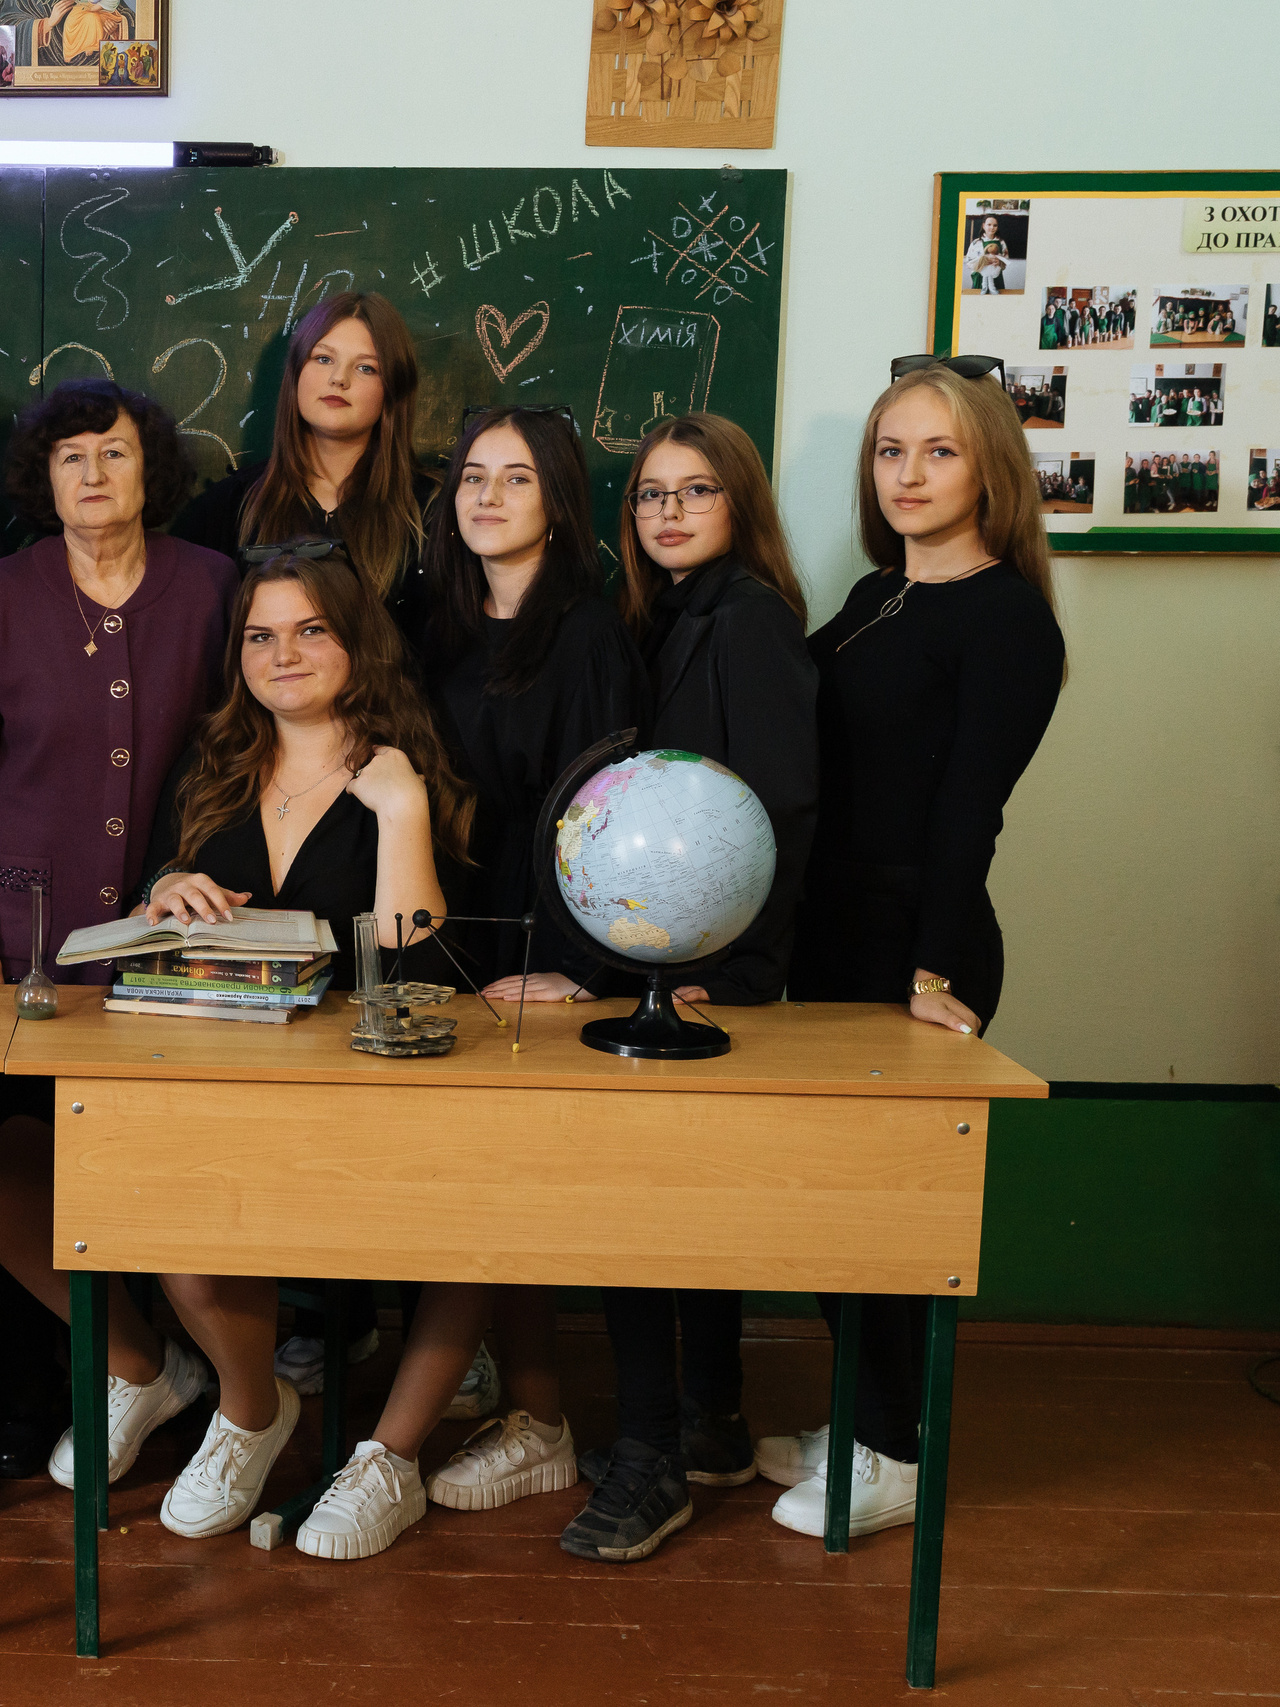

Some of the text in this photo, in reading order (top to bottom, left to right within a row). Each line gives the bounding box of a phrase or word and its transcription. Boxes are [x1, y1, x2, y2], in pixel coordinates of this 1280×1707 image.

[1196, 232, 1280, 252] ДО ПРА
[173, 964, 205, 976] Фізика
[130, 976, 145, 984] 2017
[180, 979, 241, 990] правознавства
[126, 987, 183, 997] УКРАЇНСЬКА МОВА
[243, 983, 275, 993] Основи
